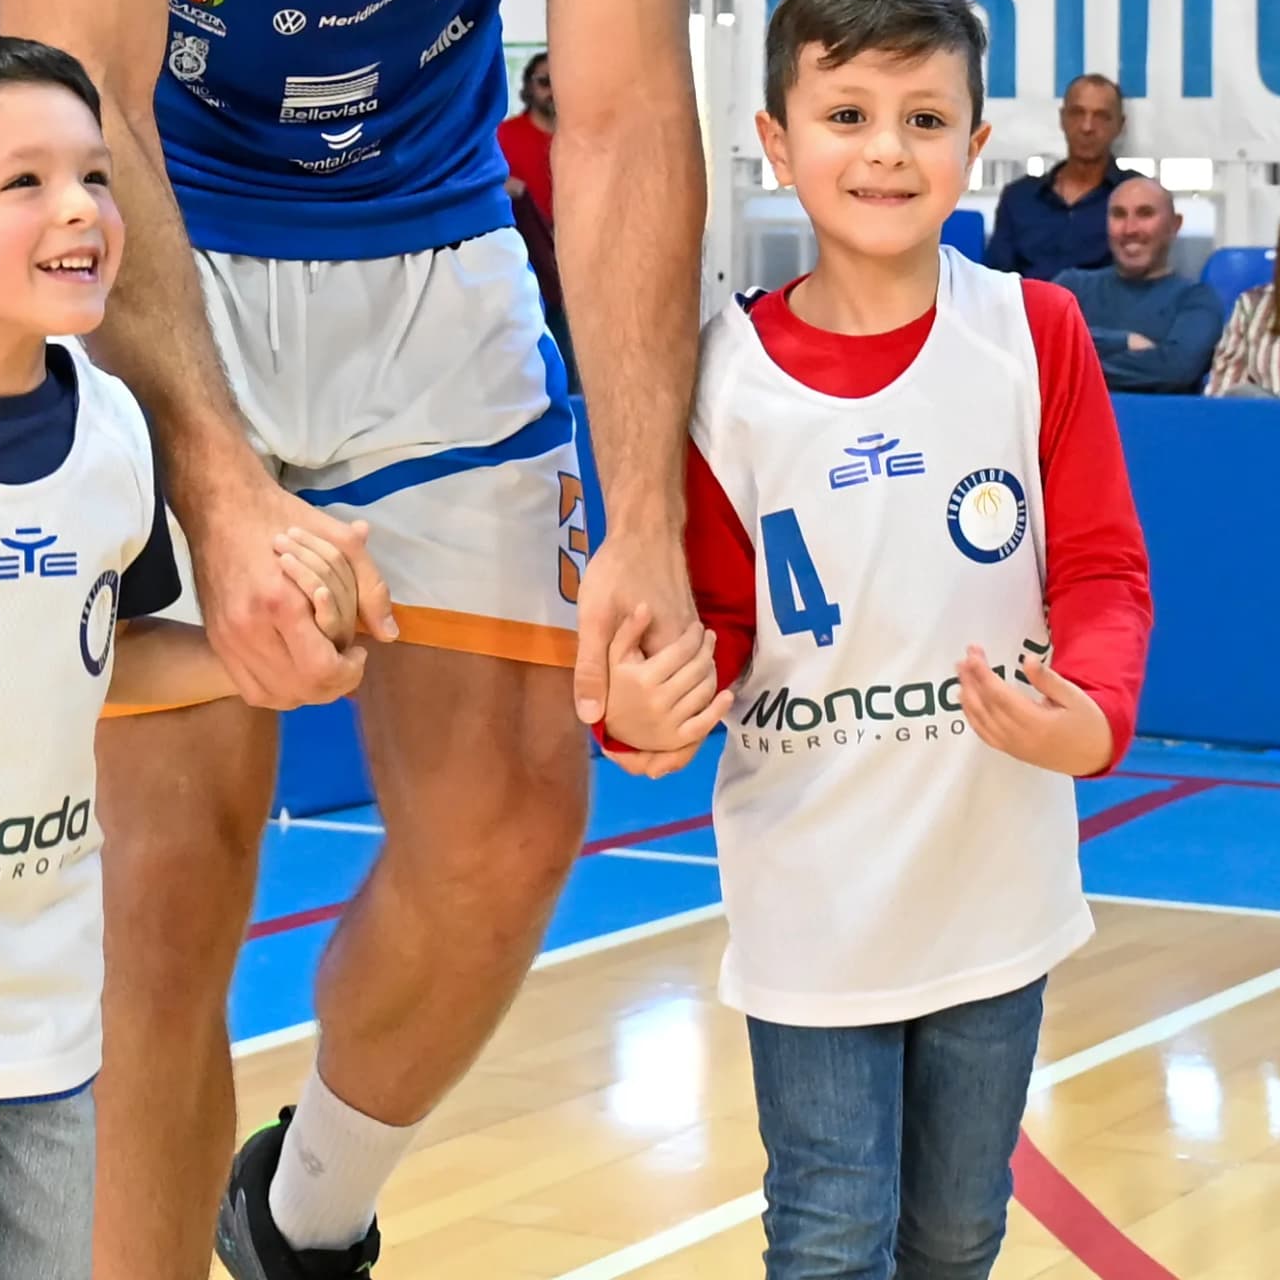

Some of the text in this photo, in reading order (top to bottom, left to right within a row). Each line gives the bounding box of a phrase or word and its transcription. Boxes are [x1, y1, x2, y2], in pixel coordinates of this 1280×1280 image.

[280, 99, 379, 120] Bellavista
[760, 508, 841, 647] 4
[895, 718, 966, 743] GRO
